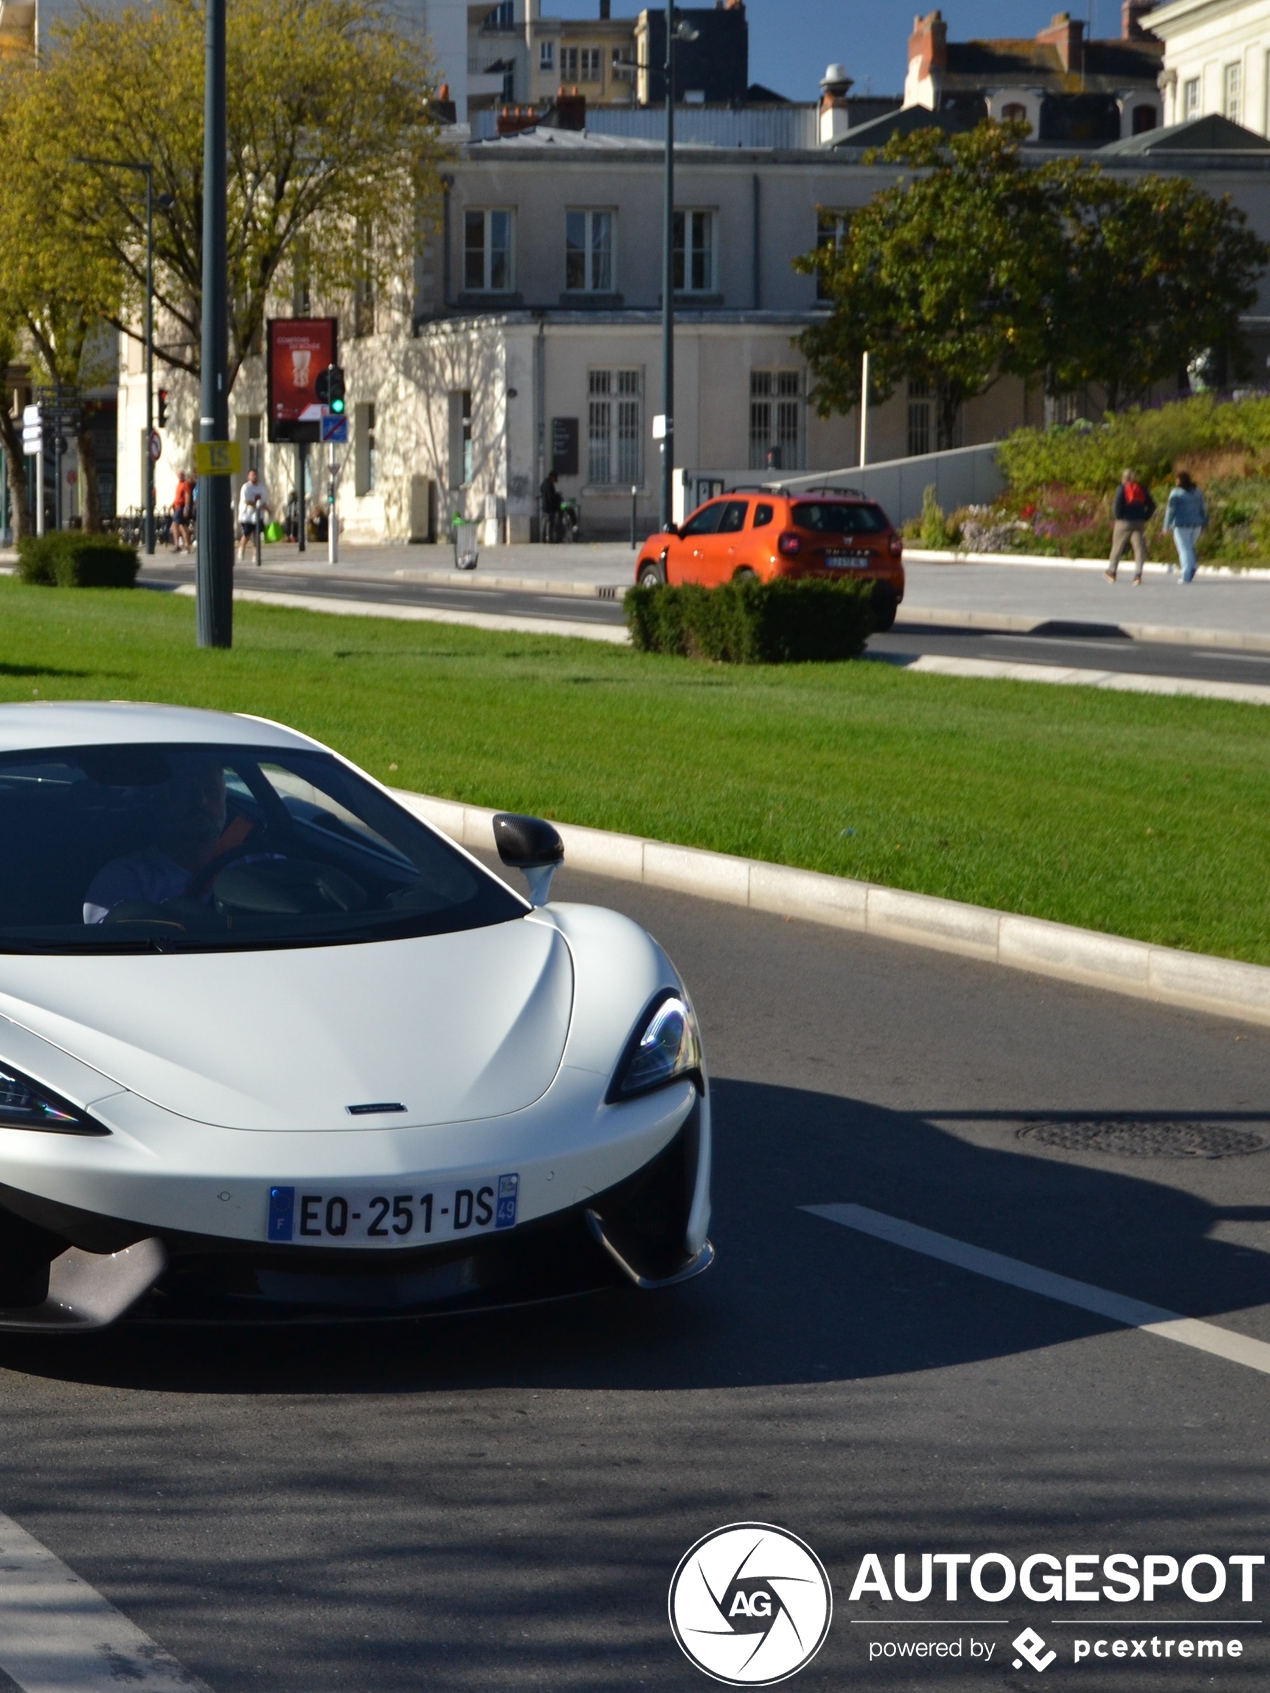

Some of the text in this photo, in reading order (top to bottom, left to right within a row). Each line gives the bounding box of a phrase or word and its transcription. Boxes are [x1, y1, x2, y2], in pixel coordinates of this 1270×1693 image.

[299, 1186, 494, 1237] EQ-251-DS
[497, 1200, 515, 1220] 49
[276, 1217, 284, 1230] F
